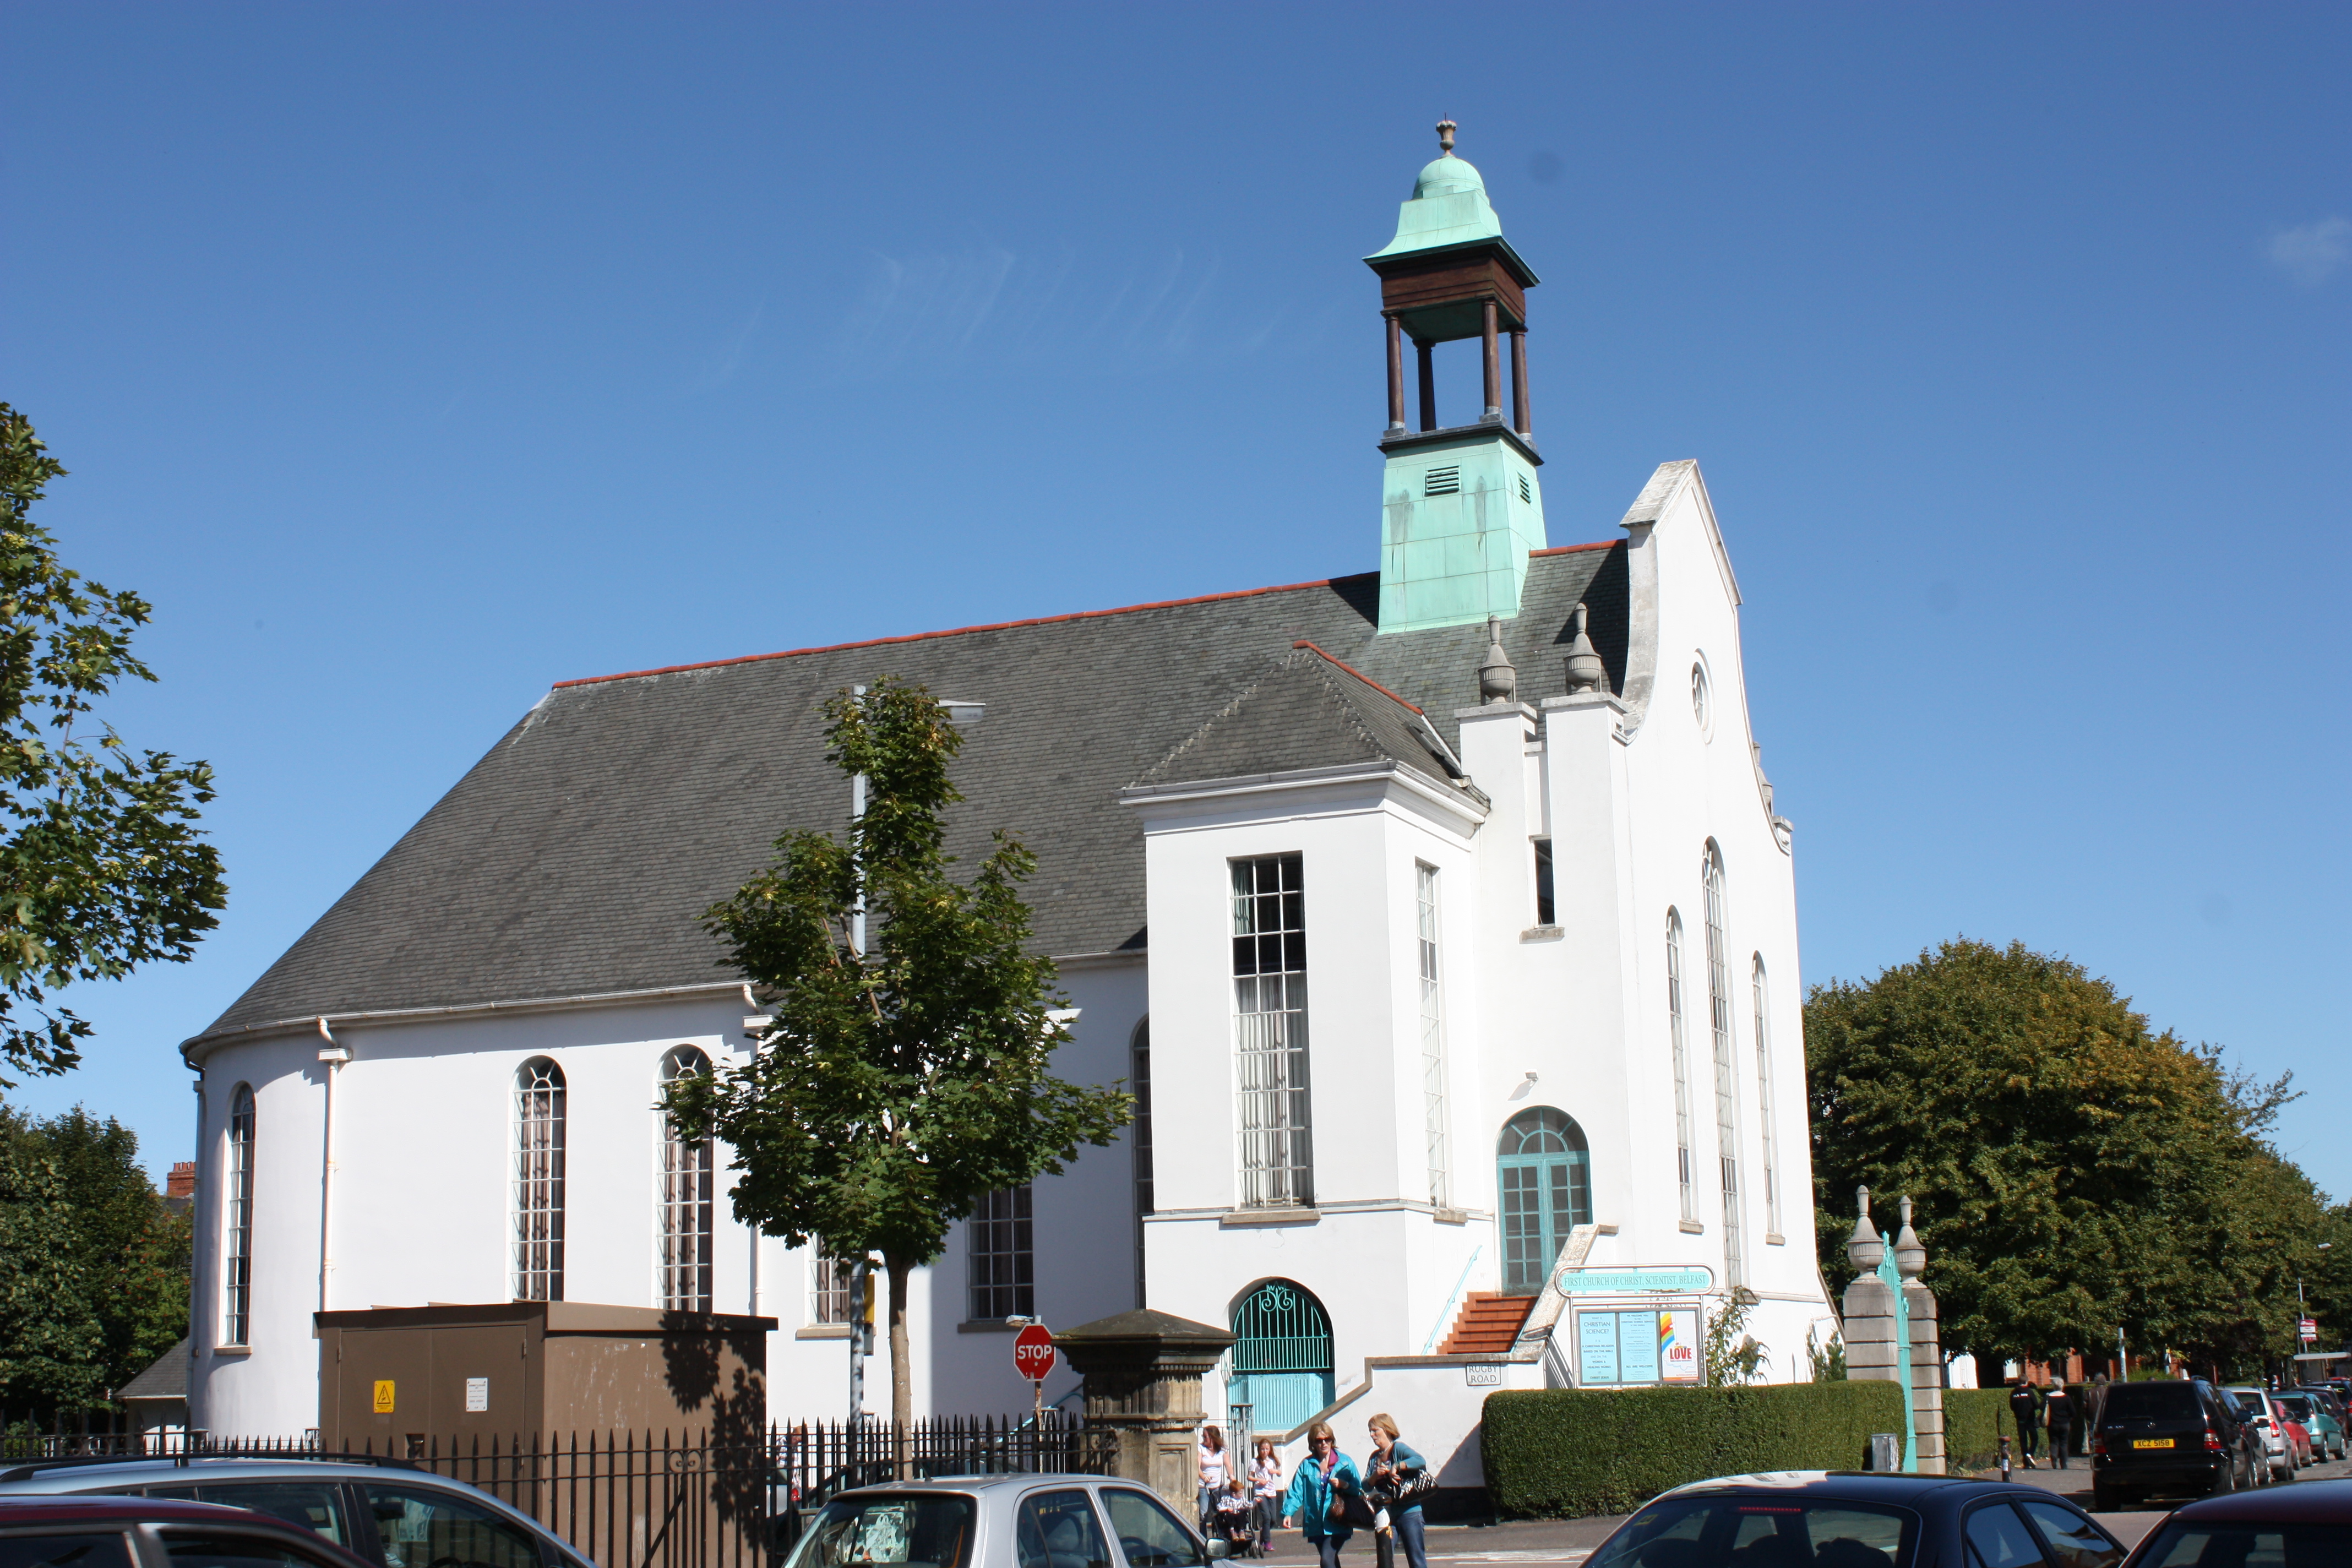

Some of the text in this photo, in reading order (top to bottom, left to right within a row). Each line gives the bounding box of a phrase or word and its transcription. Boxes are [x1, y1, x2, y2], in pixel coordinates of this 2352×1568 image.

[1564, 1277, 1581, 1286] FIRST
[1583, 1276, 1609, 1286] CHURCH
[1610, 1276, 1619, 1286] OF
[1620, 1276, 1644, 1286] CHRIST,
[1679, 1275, 1706, 1284] BELFAST
[1017, 1344, 1052, 1360] STOP
[1669, 1348, 1692, 1359] LOVE
[1471, 1375, 1496, 1383] ROAD
